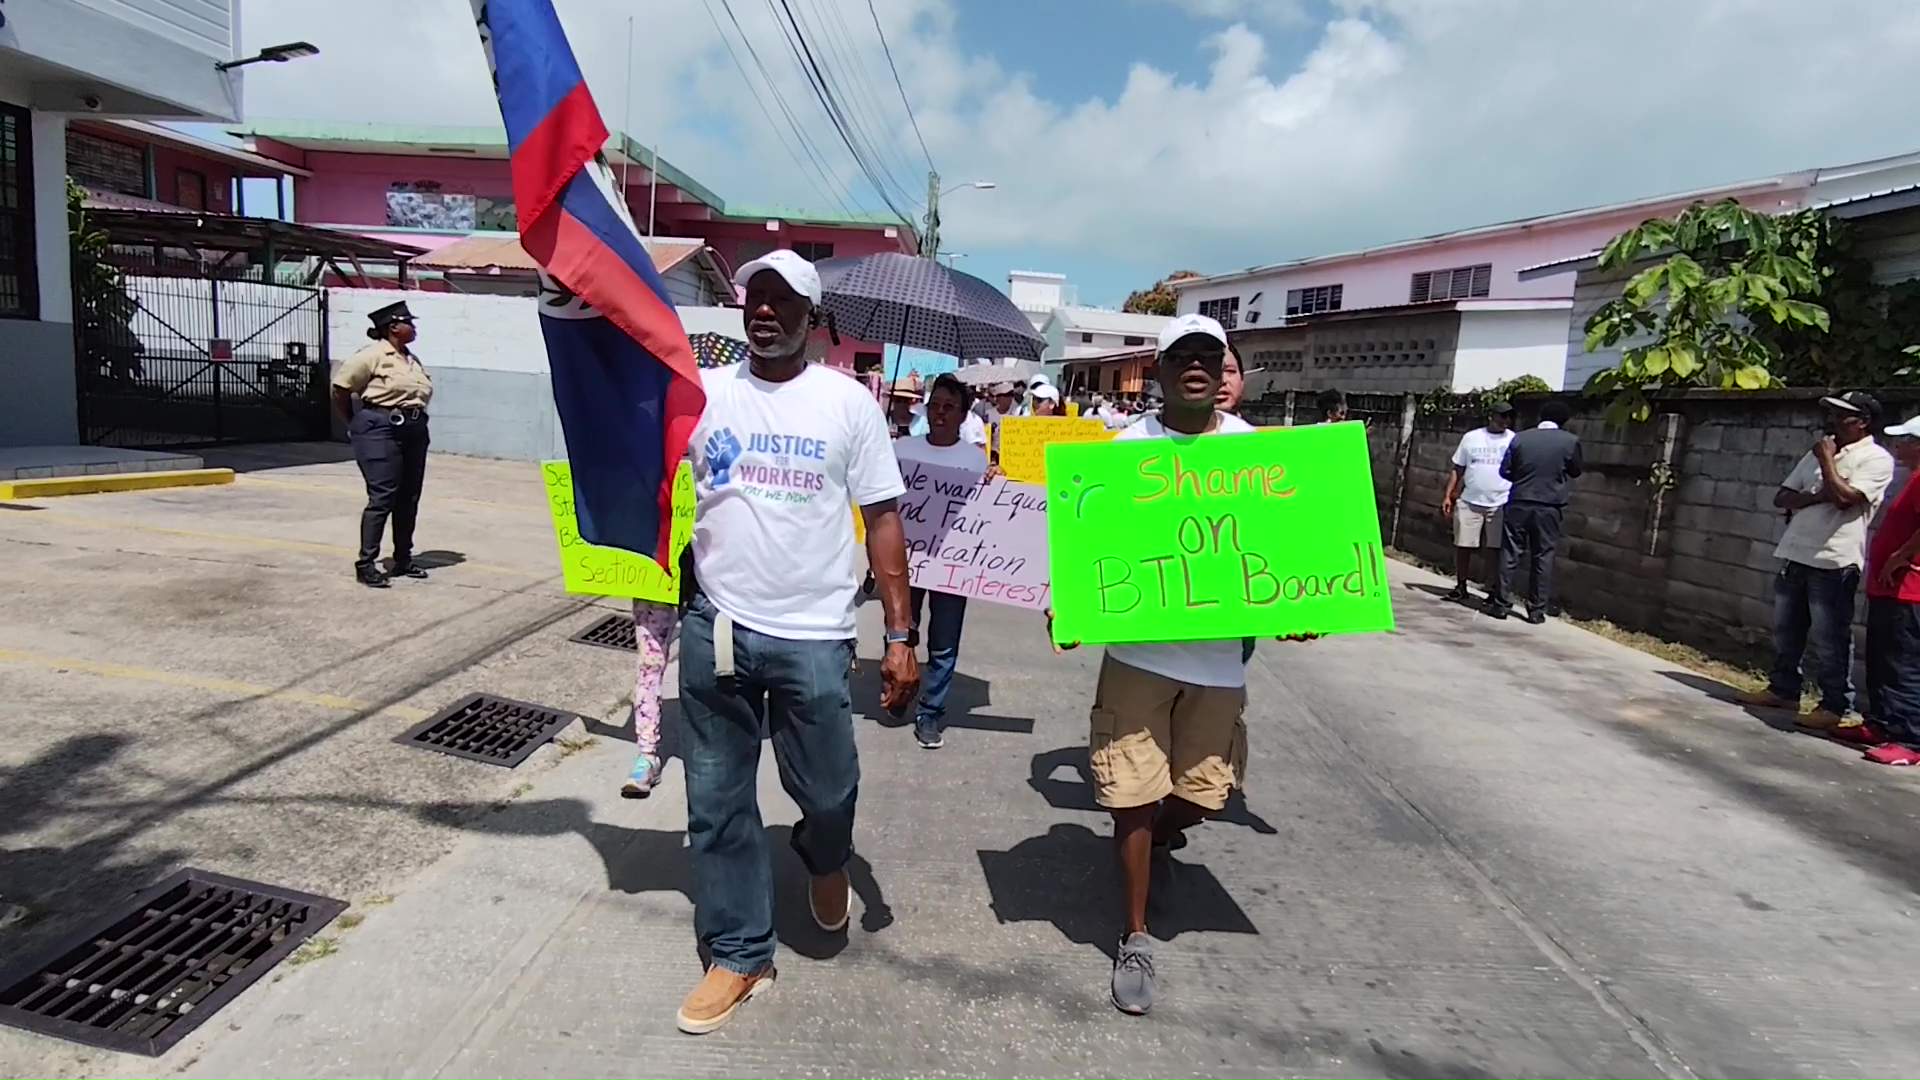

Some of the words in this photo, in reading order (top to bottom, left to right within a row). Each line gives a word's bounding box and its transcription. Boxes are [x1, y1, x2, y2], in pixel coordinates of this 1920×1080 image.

[747, 433, 827, 460] JUSTICE
[775, 455, 789, 466] FOR
[740, 464, 825, 491] WORKERS
[899, 463, 928, 490] We
[934, 478, 989, 502] want
[993, 479, 1048, 521] Equa
[1133, 452, 1297, 503] Shame
[898, 495, 930, 524] nd
[941, 500, 992, 536] Fair
[1178, 512, 1242, 555] on
[579, 554, 649, 587] Section
[904, 534, 1026, 576] plication
[936, 563, 1050, 606] Interest
[1092, 555, 1220, 614] BTL
